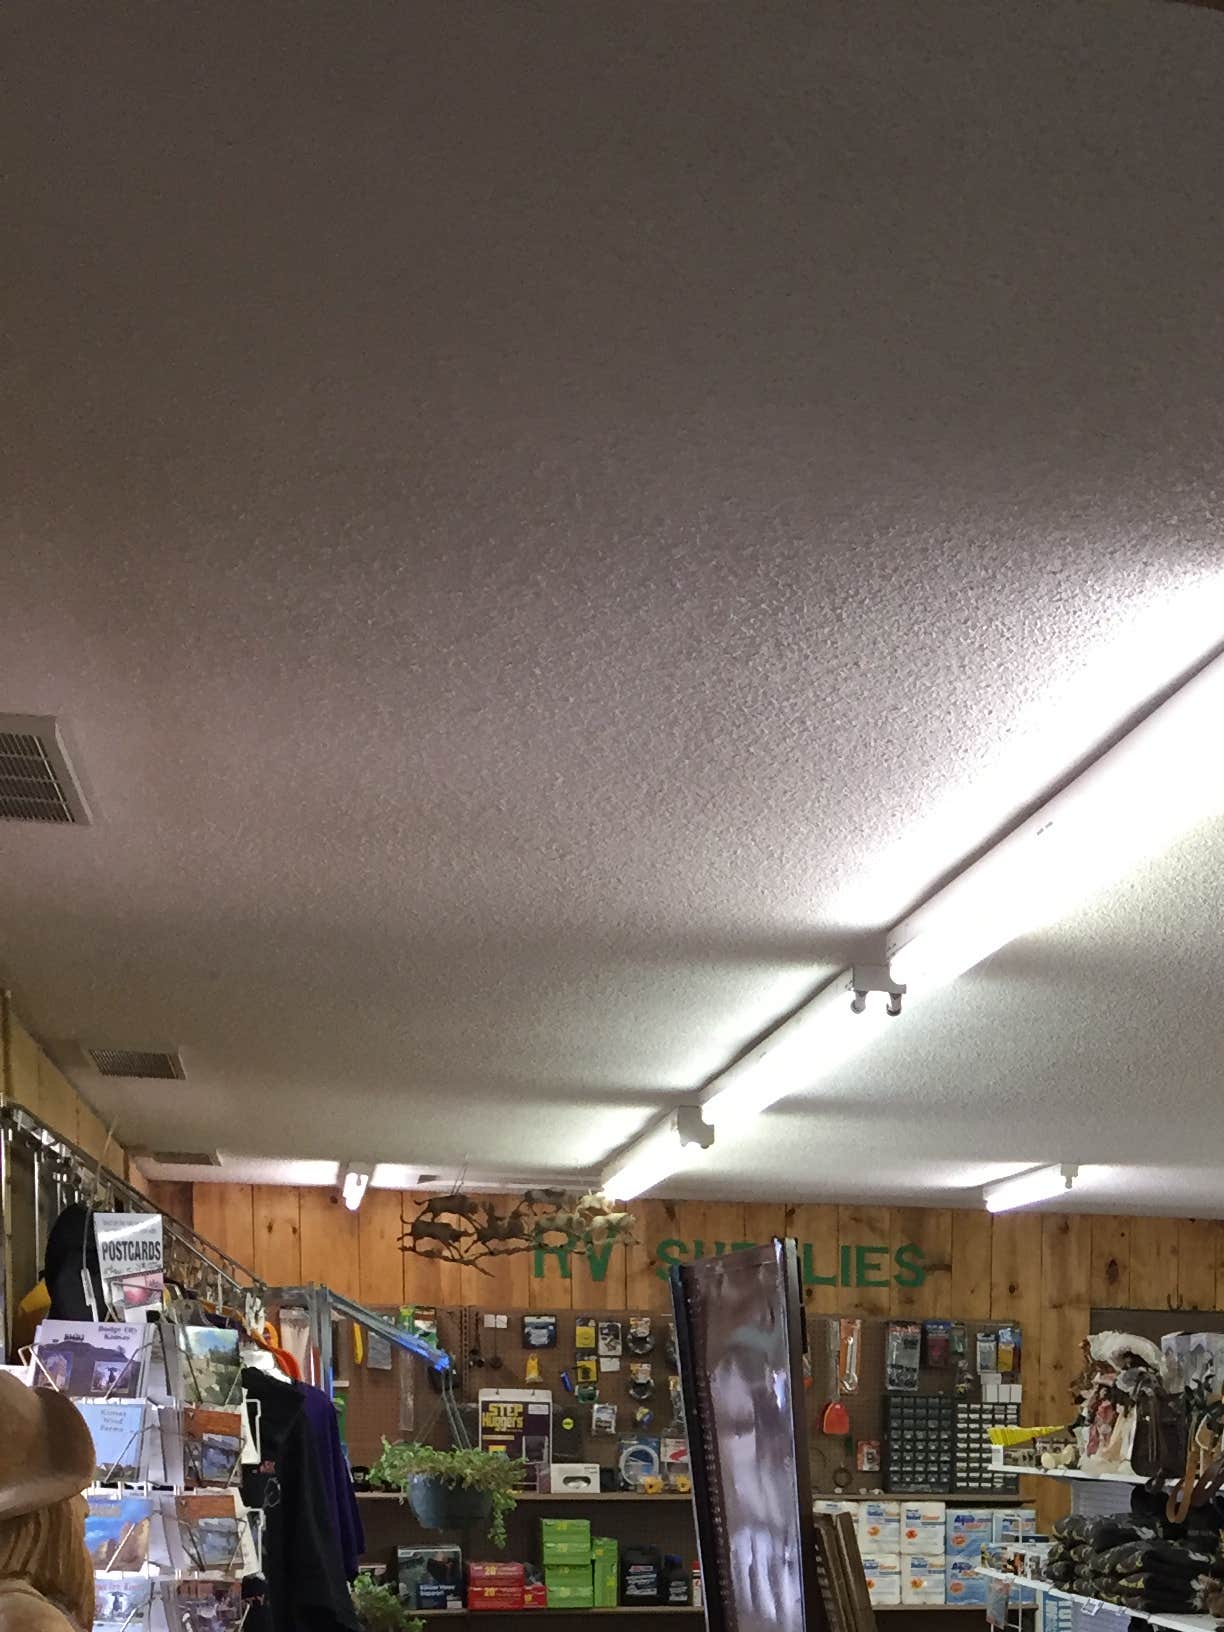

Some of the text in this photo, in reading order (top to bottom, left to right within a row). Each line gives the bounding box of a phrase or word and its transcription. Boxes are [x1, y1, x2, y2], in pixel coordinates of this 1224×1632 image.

[101, 1240, 161, 1262] POSTCARDS
[534, 1221, 928, 1289] RV SLIES
[488, 1403, 524, 1417] STEP
